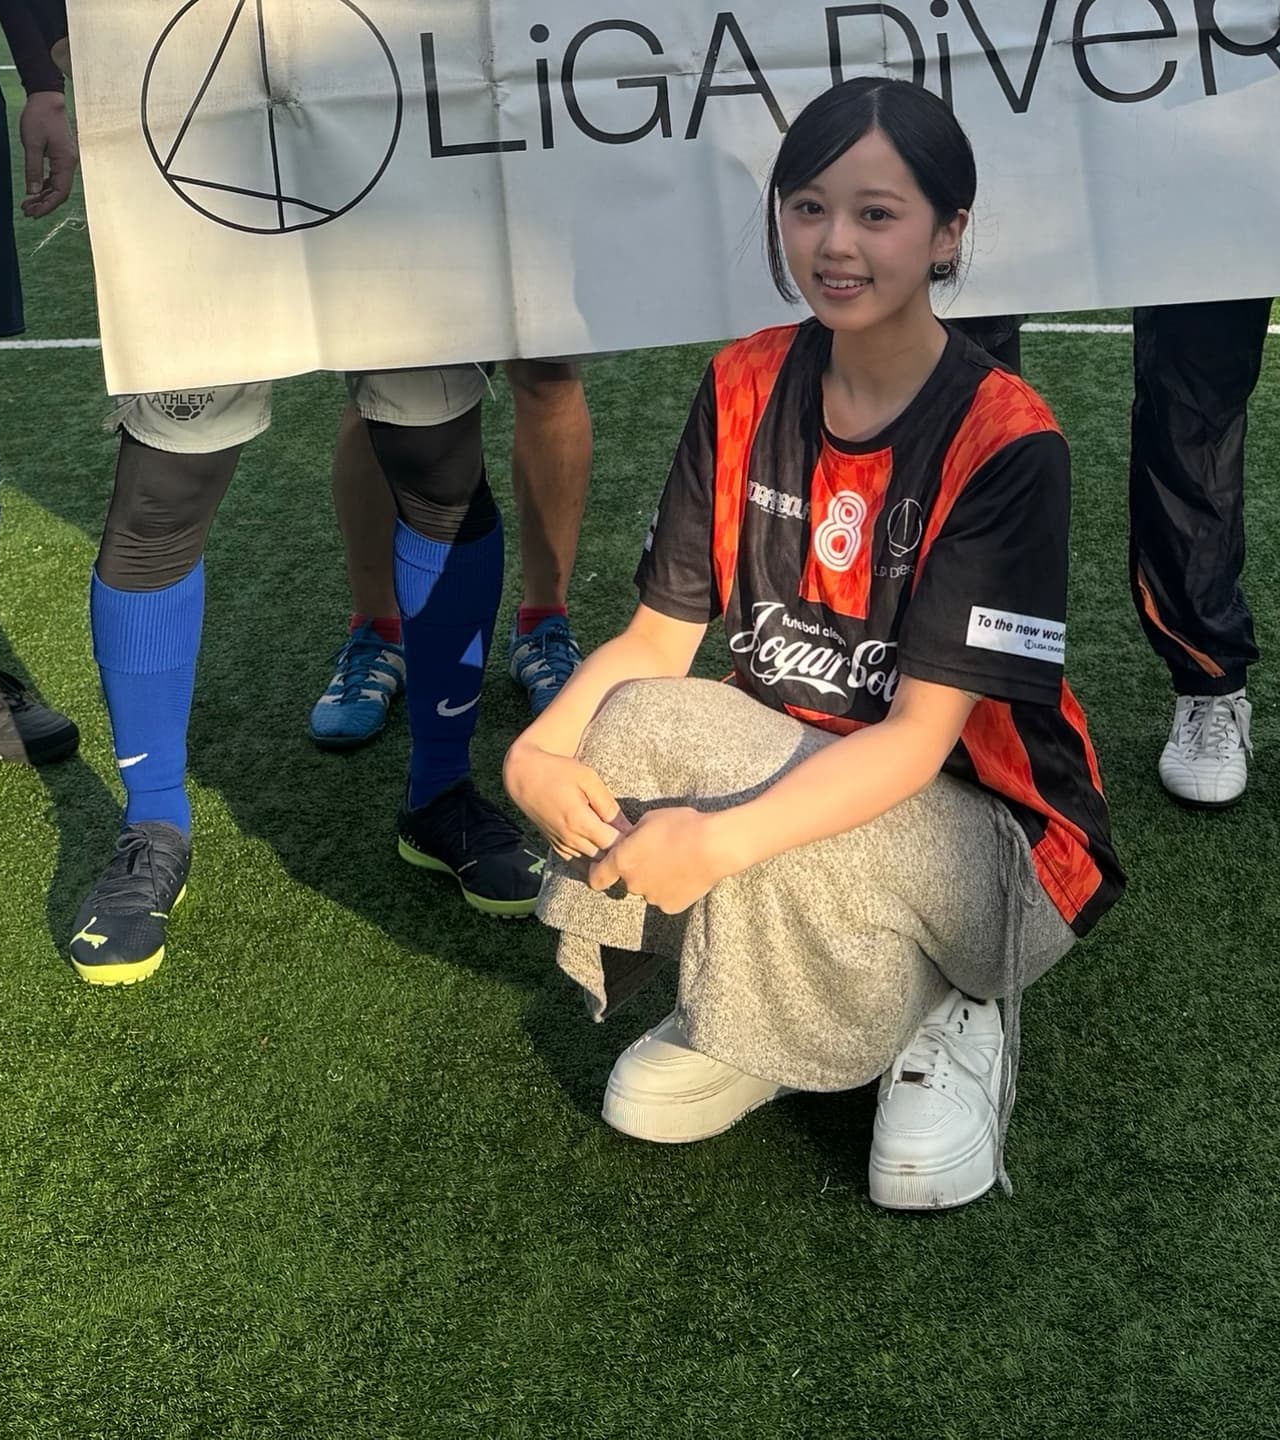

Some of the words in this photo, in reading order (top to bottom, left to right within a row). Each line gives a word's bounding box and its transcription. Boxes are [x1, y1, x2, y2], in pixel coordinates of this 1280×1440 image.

[151, 392, 214, 405] ATHLETA
[814, 490, 868, 573] 8
[782, 613, 820, 636] futebol
[978, 615, 992, 628] To
[994, 619, 1013, 632] the
[1015, 624, 1040, 637] new
